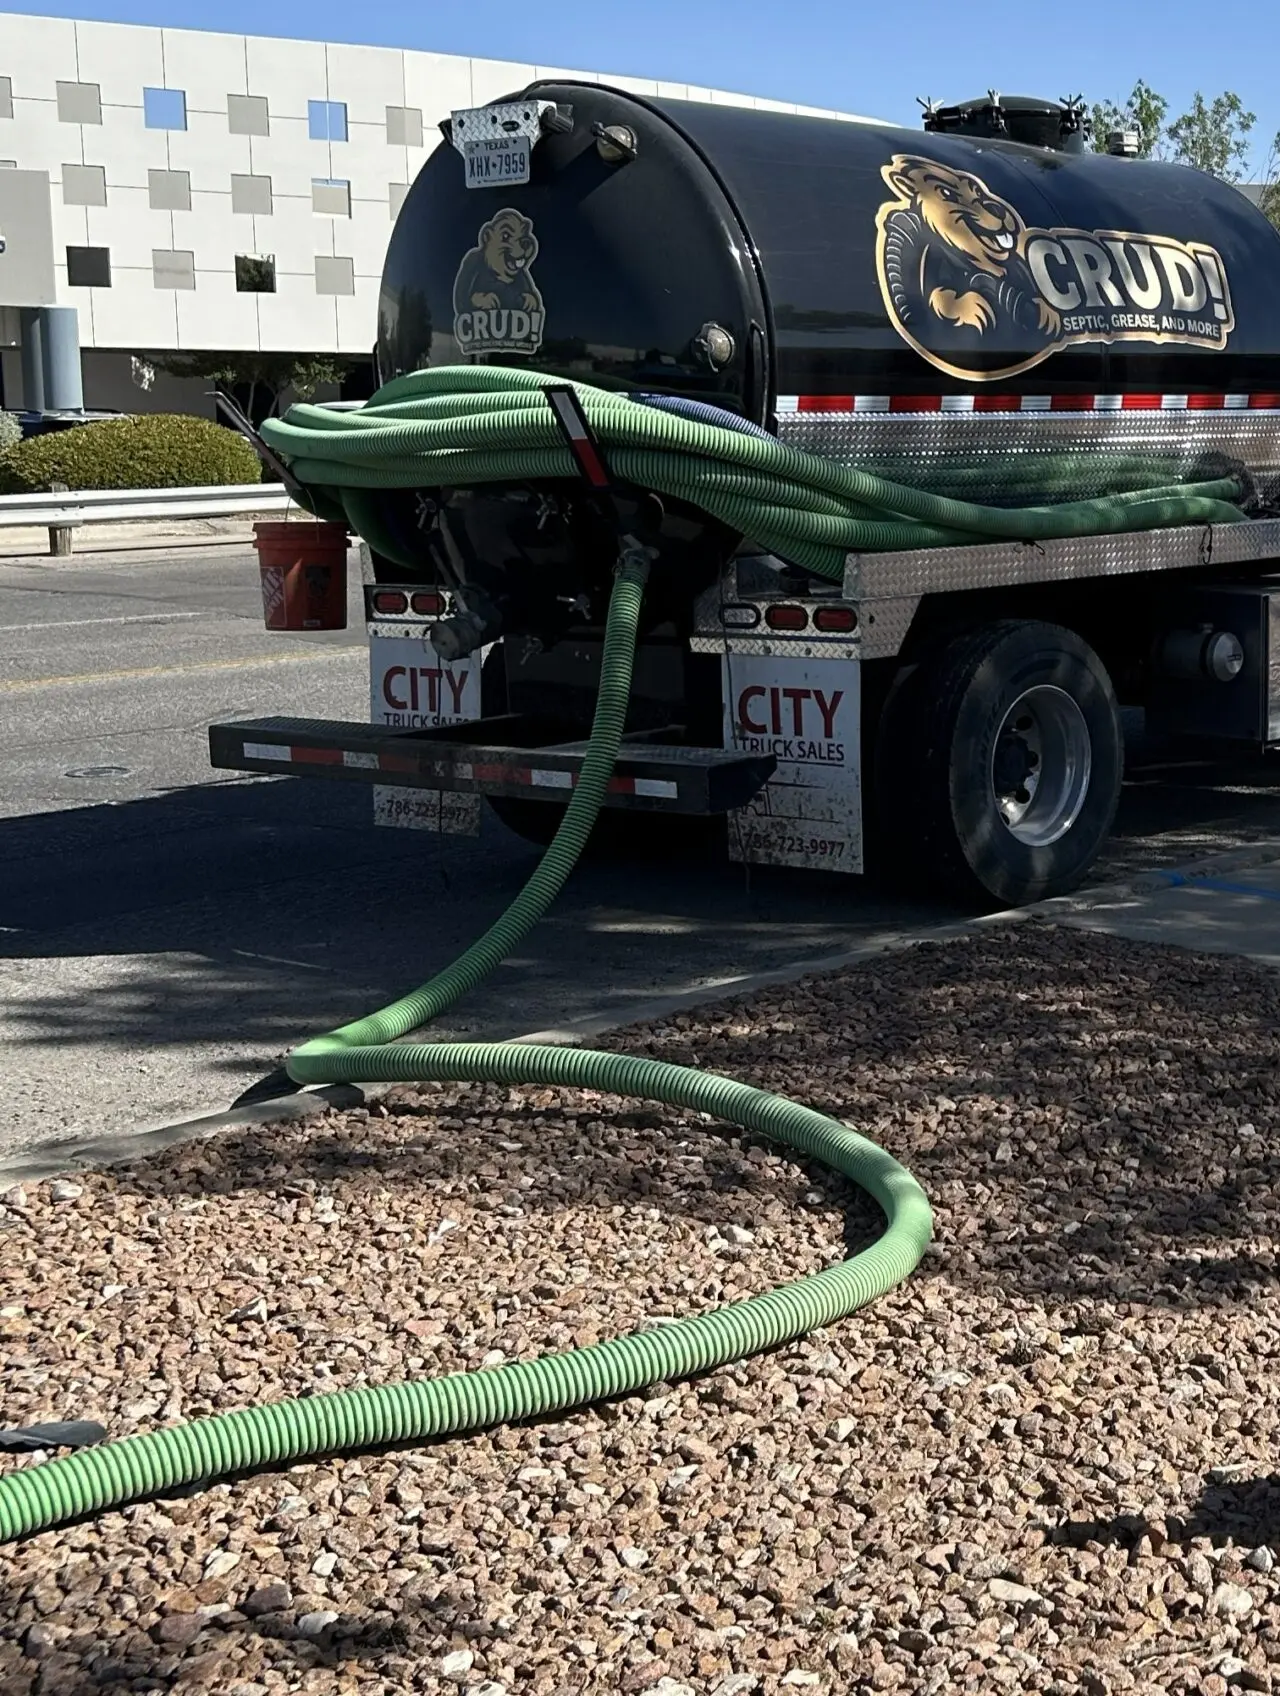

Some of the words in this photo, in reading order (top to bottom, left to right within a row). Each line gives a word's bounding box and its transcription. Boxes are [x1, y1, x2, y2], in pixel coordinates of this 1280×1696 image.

[483, 141, 509, 151] TEXAS
[1027, 238, 1228, 321] CRUD!
[457, 309, 541, 343] CRUD!
[1063, 314, 1110, 331] SEPTIC,
[1111, 314, 1160, 331] GREASE,
[1162, 317, 1185, 331] AND
[1187, 319, 1220, 337] MORE
[383, 665, 469, 714] CITY
[384, 712, 429, 728] TRUCK
[738, 685, 844, 739] CITY
[739, 736, 794, 758] TRUCK
[797, 741, 845, 762] SALES
[743, 832, 845, 858] 786-723-9977
